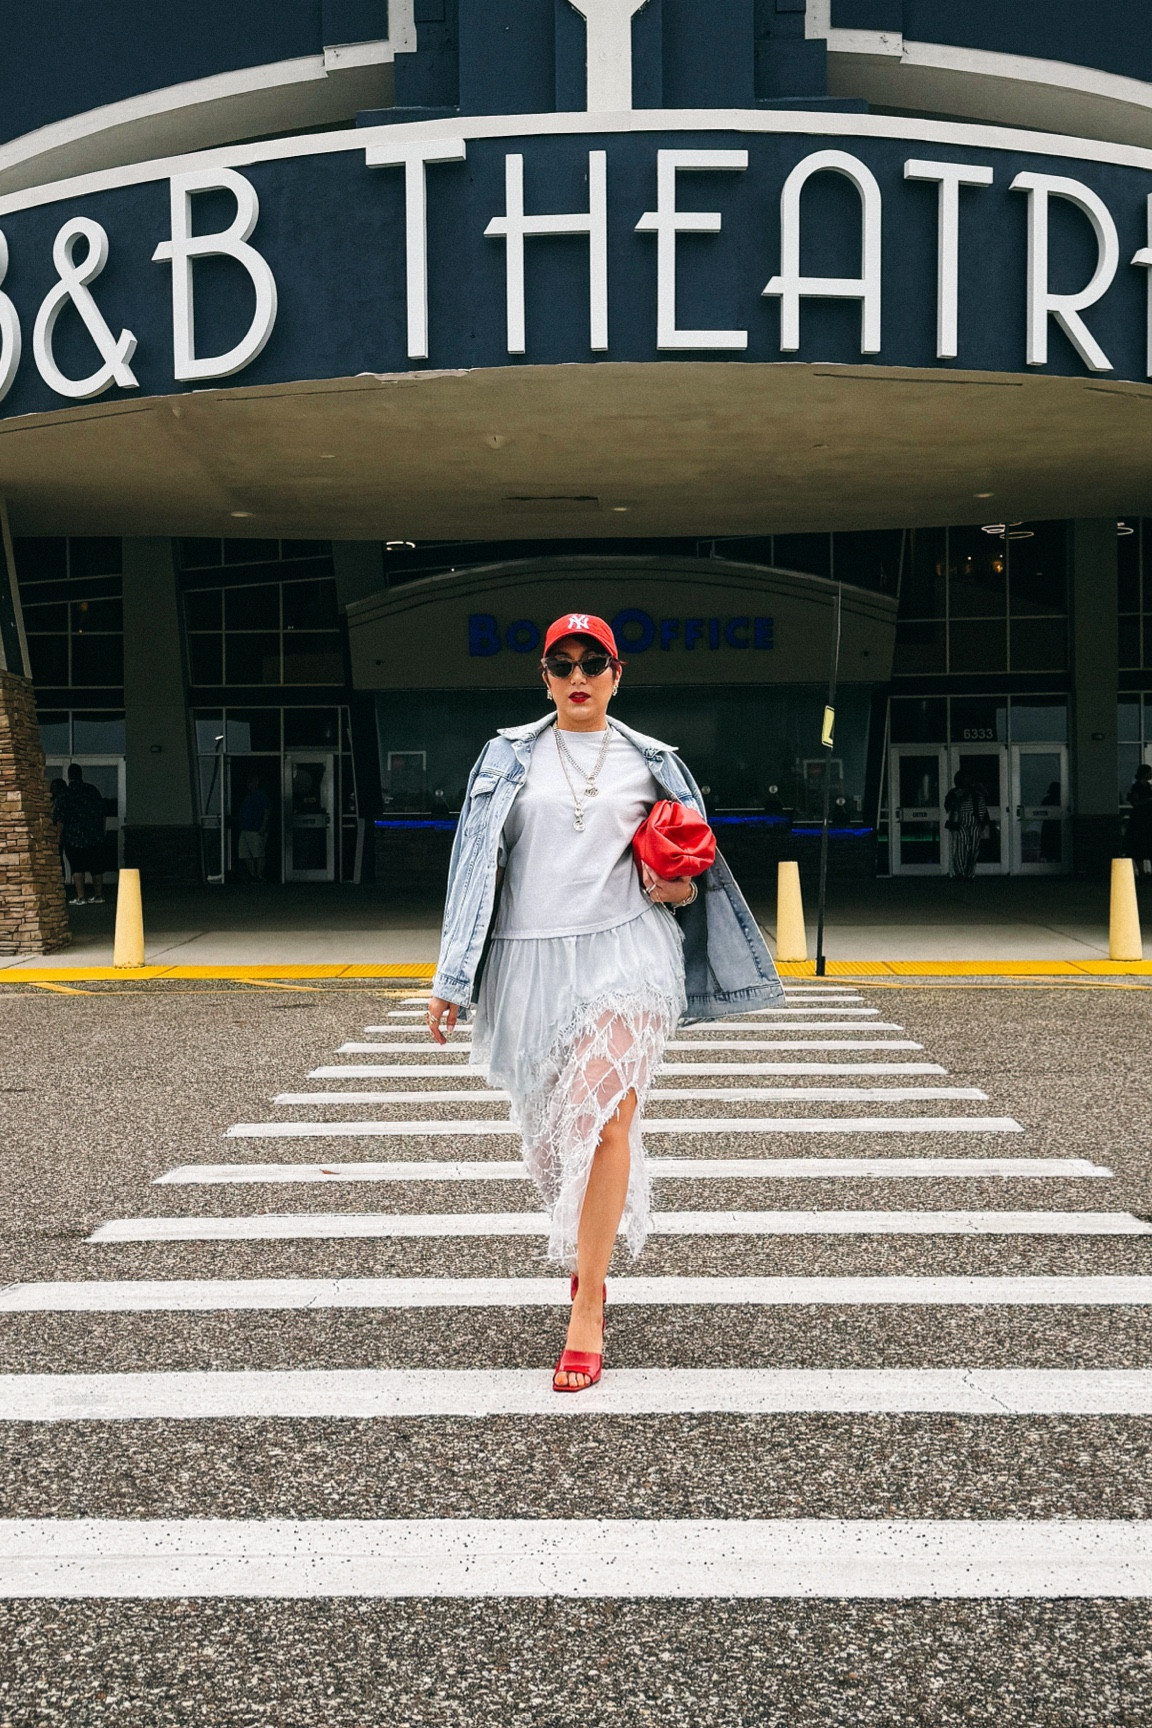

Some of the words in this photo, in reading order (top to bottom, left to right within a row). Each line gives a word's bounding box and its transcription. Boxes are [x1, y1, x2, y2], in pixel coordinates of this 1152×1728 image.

[0, 167, 277, 399] &B
[365, 139, 1152, 377] THEATR
[468, 613, 541, 657] BO
[611, 608, 774, 654] OFFICE
[568, 615, 590, 630] NY
[963, 728, 993, 740] 6333
